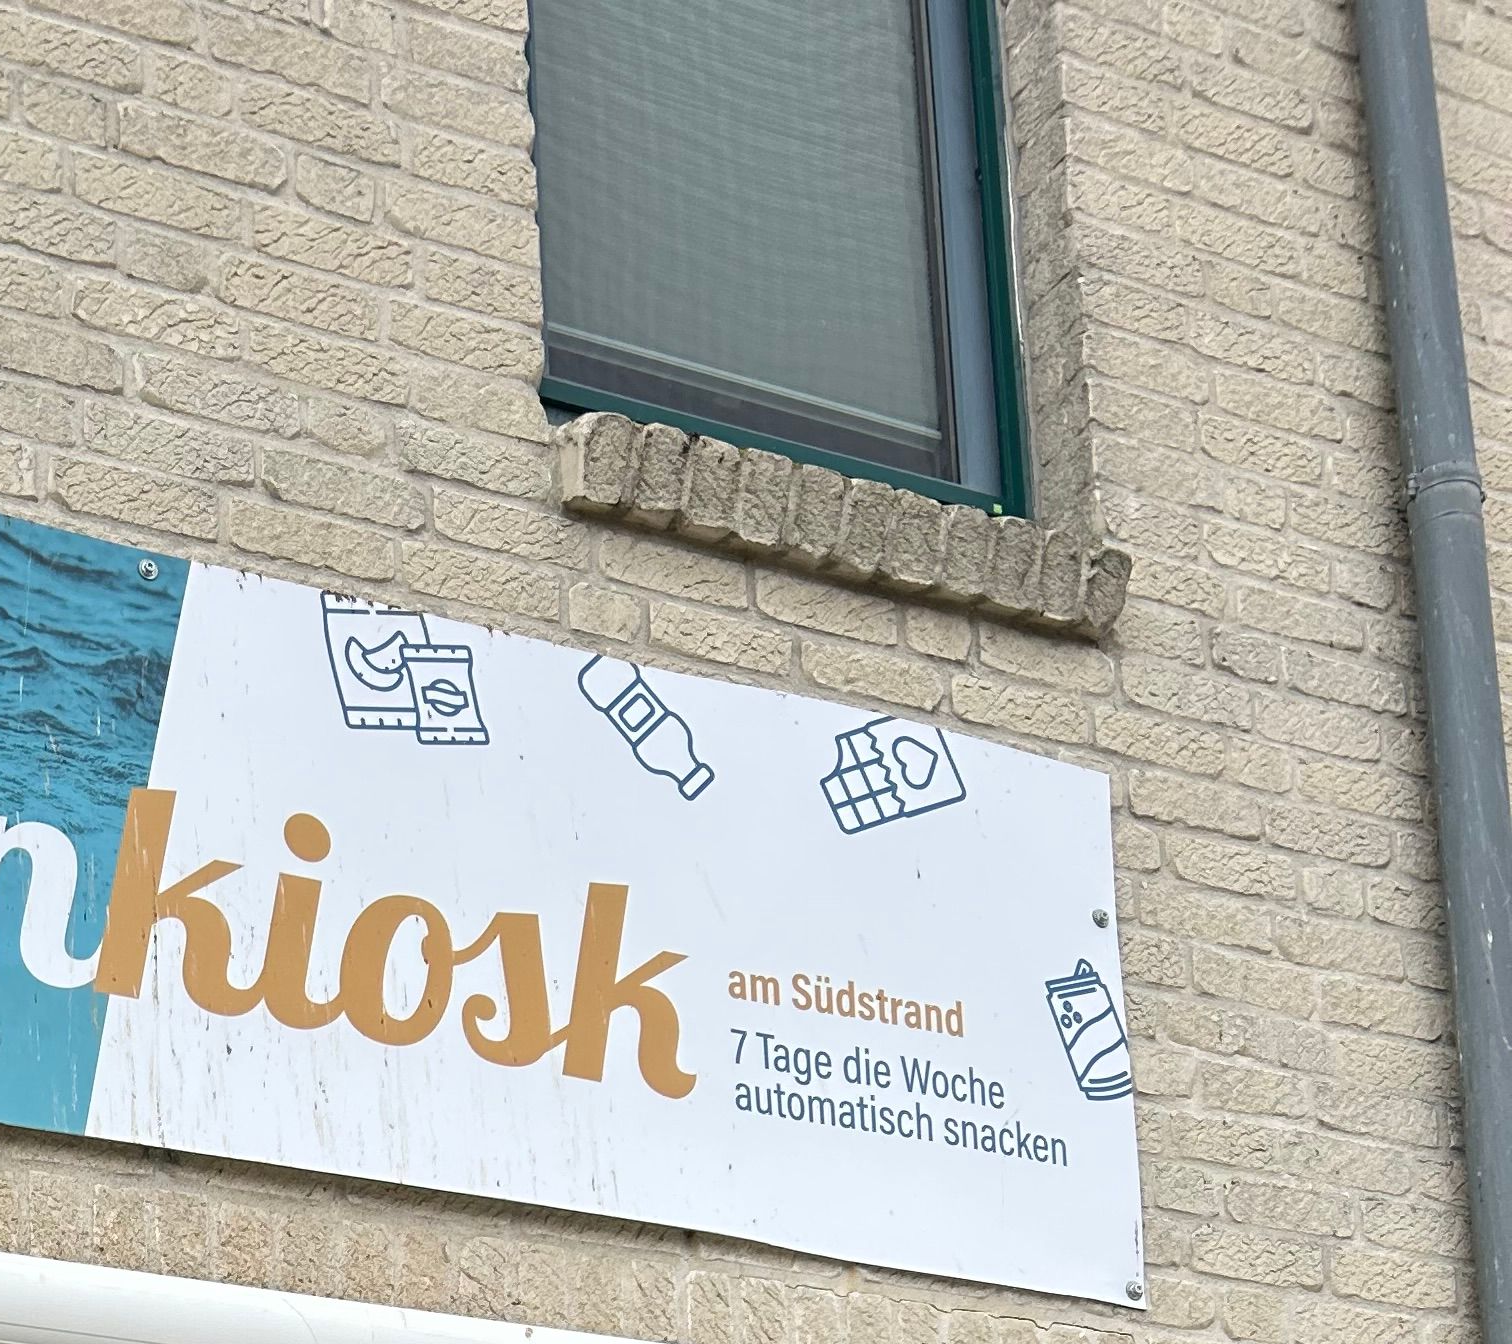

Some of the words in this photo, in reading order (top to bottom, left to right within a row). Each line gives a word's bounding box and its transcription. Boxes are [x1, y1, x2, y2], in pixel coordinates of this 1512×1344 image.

[728, 970, 781, 1006] am
[791, 973, 965, 1038] Südstrand
[730, 1028, 748, 1065] 7
[755, 1031, 833, 1086] Tage
[842, 1045, 891, 1089] die
[899, 1055, 1006, 1110] Woche
[734, 1082, 934, 1142] automatisch
[943, 1120, 1068, 1167] snacken
